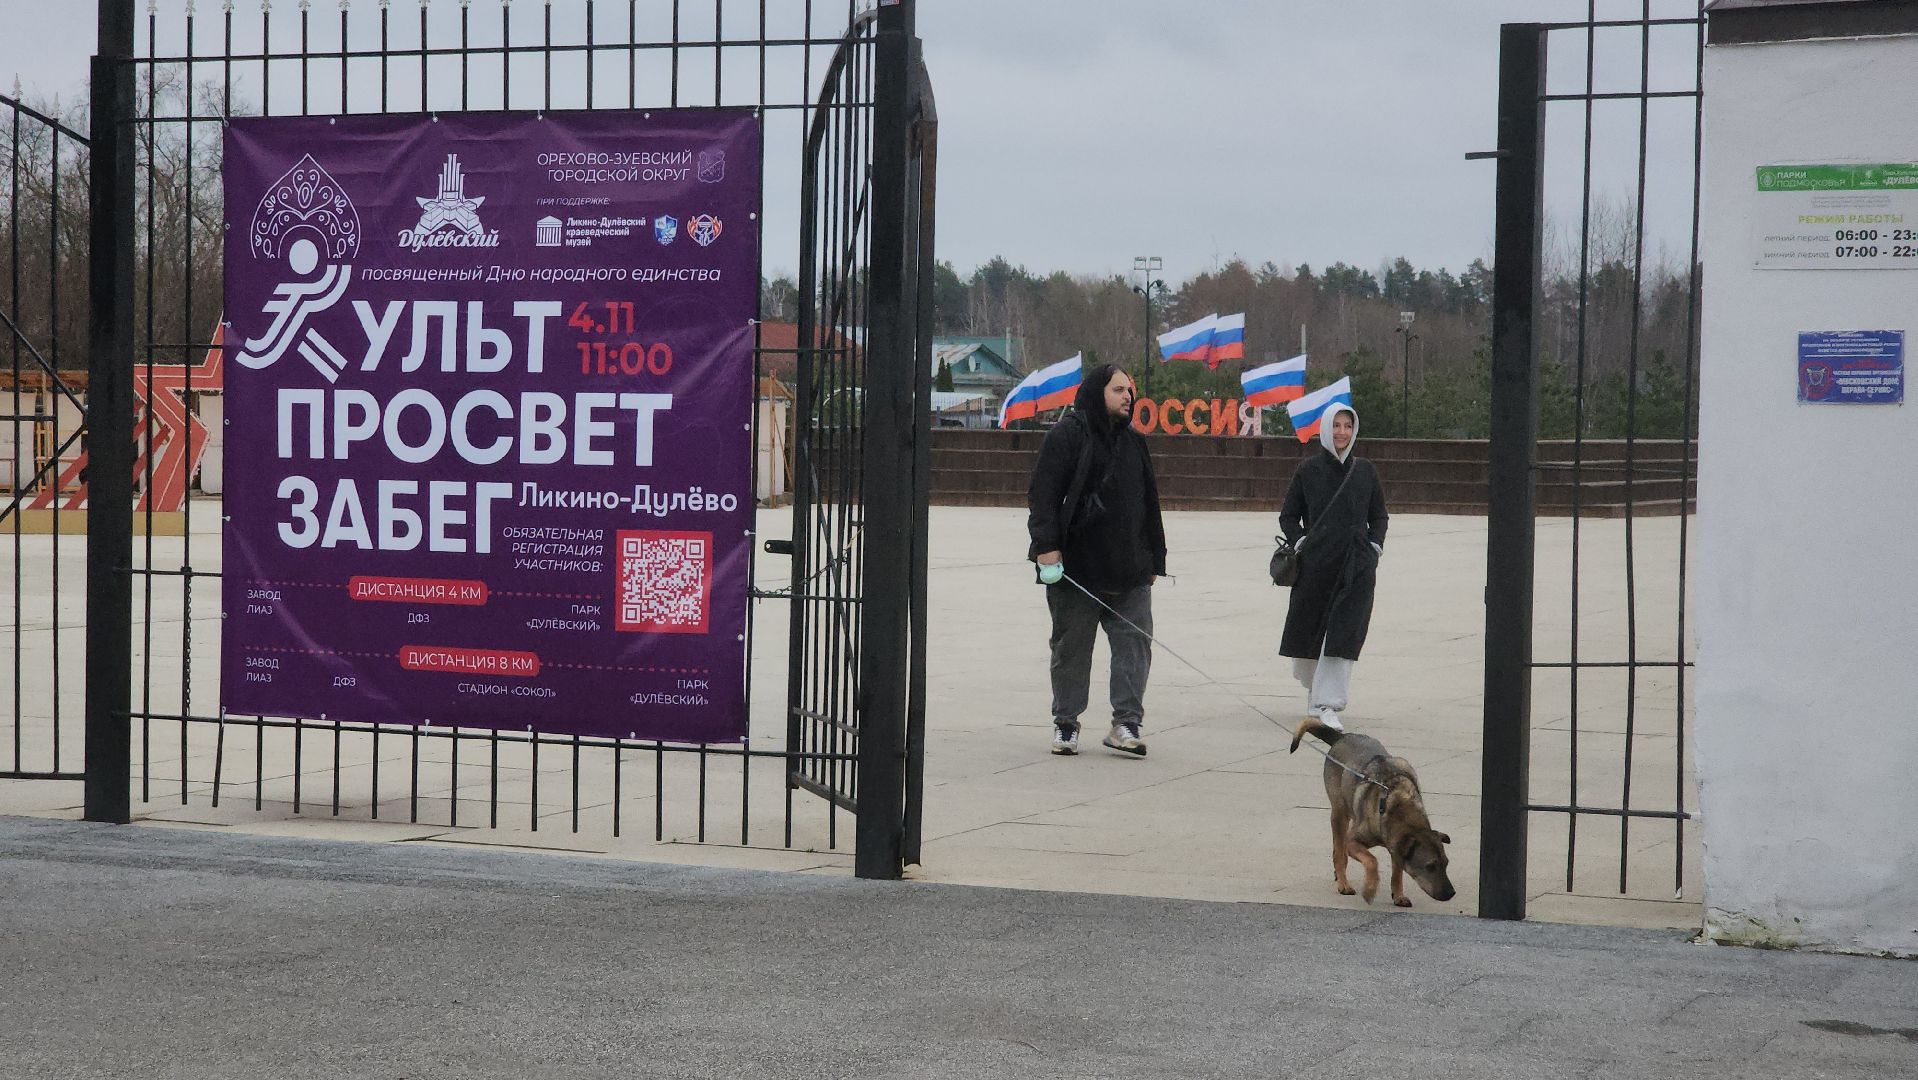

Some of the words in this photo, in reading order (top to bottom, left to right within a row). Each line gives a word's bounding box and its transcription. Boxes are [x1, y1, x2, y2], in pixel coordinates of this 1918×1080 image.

[537, 149, 692, 166] ОРЕХОВО-ЗУЕВСКИЙ
[548, 166, 639, 183] ГОРОДСКОЙ
[642, 168, 691, 182] ОКРУГ
[536, 198, 555, 206] ПРИ
[567, 216, 647, 228] Ликино-Дулёвский
[1798, 214, 1845, 224] РЕЖИМ
[1850, 214, 1904, 224] РАБОТЫ
[566, 227, 630, 237] краеведческий
[1835, 229, 1878, 241] 06:00
[398, 229, 500, 252] Дулёвский
[565, 237, 592, 247] музей
[1835, 246, 1878, 258] 07:00
[361, 265, 483, 283] посвященный
[485, 265, 526, 283] Дню
[529, 267, 627, 284] народного
[631, 267, 721, 283] единства
[568, 301, 635, 335] 4.11
[577, 342, 673, 376] 11:00
[1127, 374, 1262, 437] ОССИЯ
[277, 388, 673, 466] ПРОСВЕТ
[519, 481, 738, 517] Ликино-Дулёво
[276, 475, 513, 554] ЗАБЕГ
[502, 526, 604, 541] ОБЯЗАТЕЛЬНАЯ
[511, 543, 603, 557] РЕГИСТРАЦИЯ
[513, 558, 604, 573] УЧАСТНИКОВ:
[247, 589, 282, 601] ЗАВОД
[356, 582, 445, 599] ДИСТАНЦИЯ
[448, 586, 458, 599] 4
[461, 586, 481, 600] КМ
[246, 604, 273, 615] ЛИАЗ
[571, 604, 601, 615] ПАРК
[407, 612, 430, 624] ДФЗ
[526, 618, 601, 632] «ДУЛЁВСКИЙ»
[245, 657, 280, 670] ЗАВОД
[407, 652, 496, 669] ДИСТАНЦИЯ
[499, 656, 508, 669] 8
[512, 657, 533, 671] КМ
[245, 672, 272, 683] ЛИАЗ
[333, 676, 356, 687] ДФЗ
[677, 679, 709, 690] ПАРК
[457, 683, 508, 696] СТАДИОН
[511, 686, 557, 698] «СОКОЛ»
[629, 692, 709, 706] «ДУЛЁВСКИЙ»
